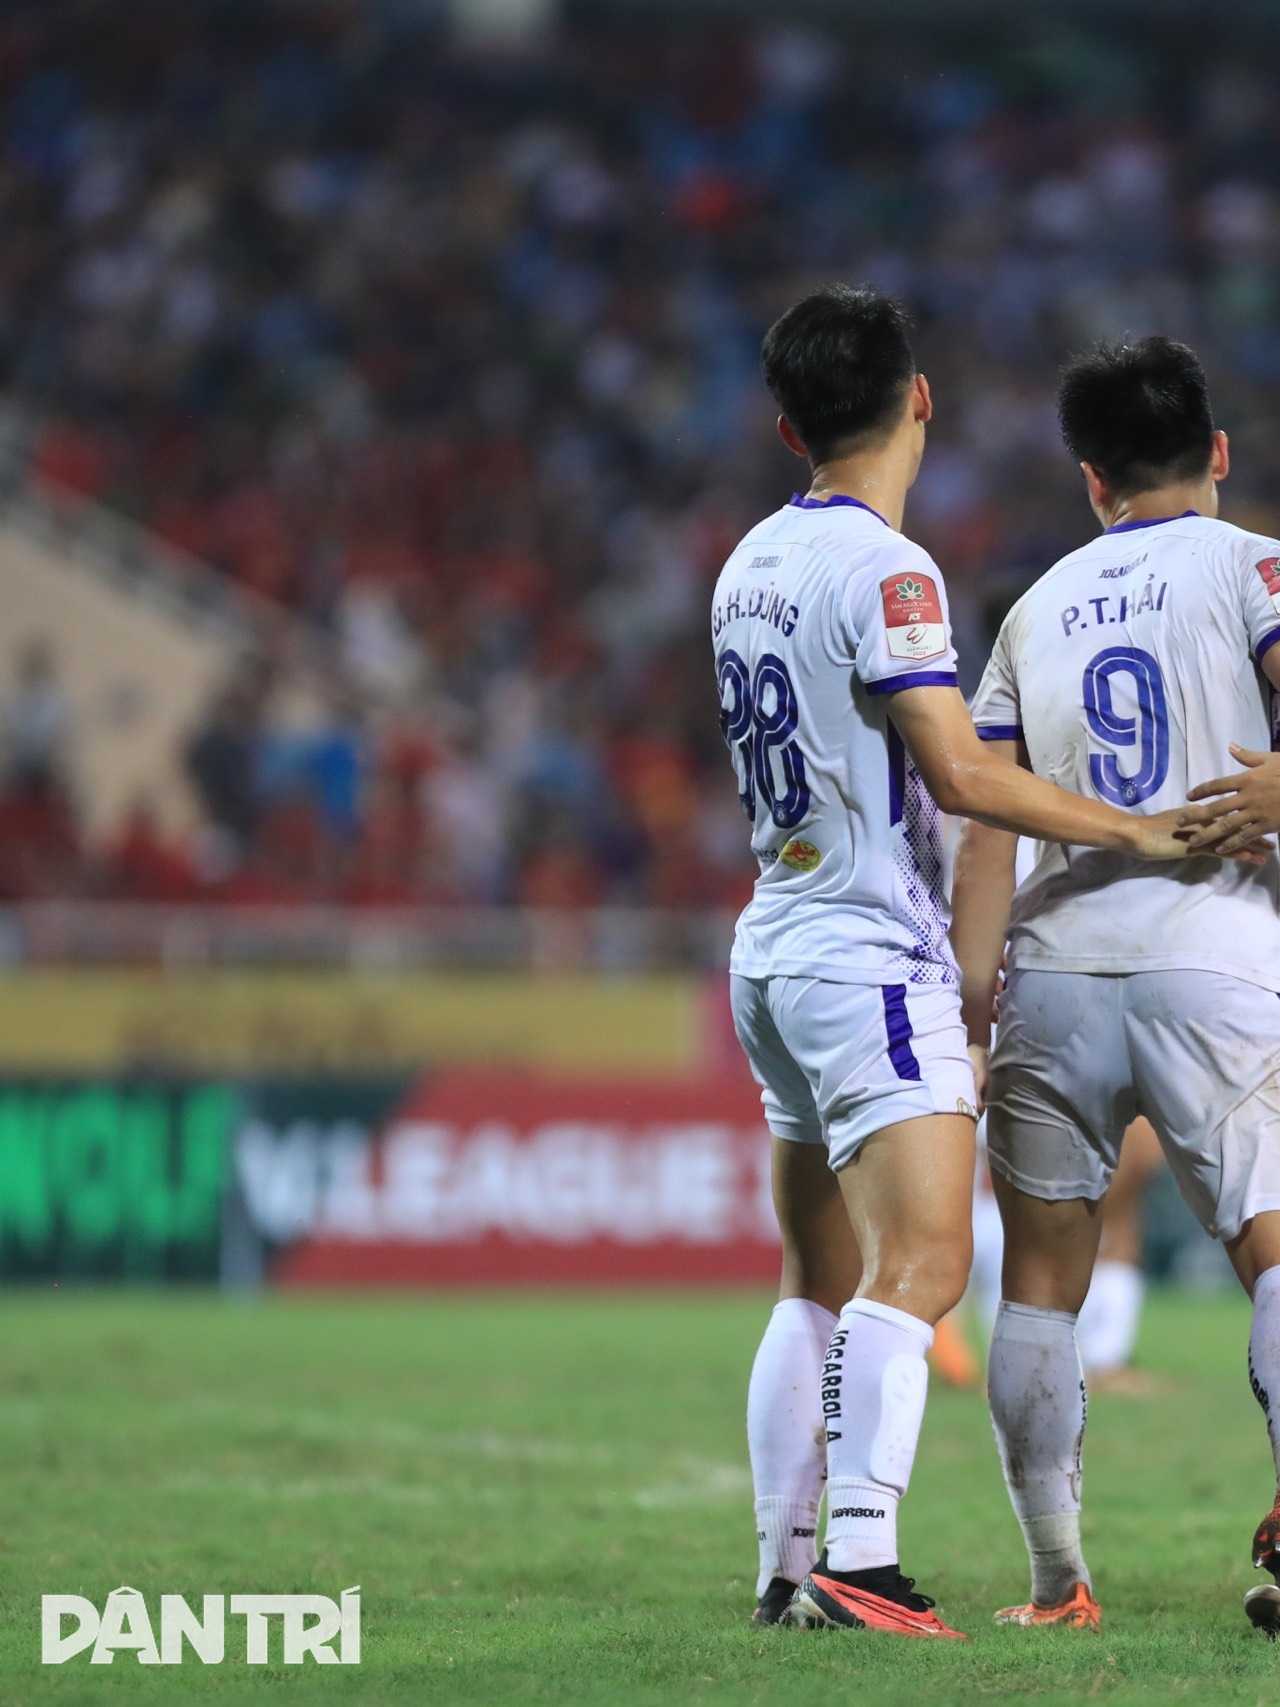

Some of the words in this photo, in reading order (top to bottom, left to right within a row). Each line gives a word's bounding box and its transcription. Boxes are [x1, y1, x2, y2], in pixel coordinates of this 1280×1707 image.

[1060, 573, 1167, 637] P.T.HẢI
[718, 648, 810, 829] 88
[1082, 646, 1169, 807] 9
